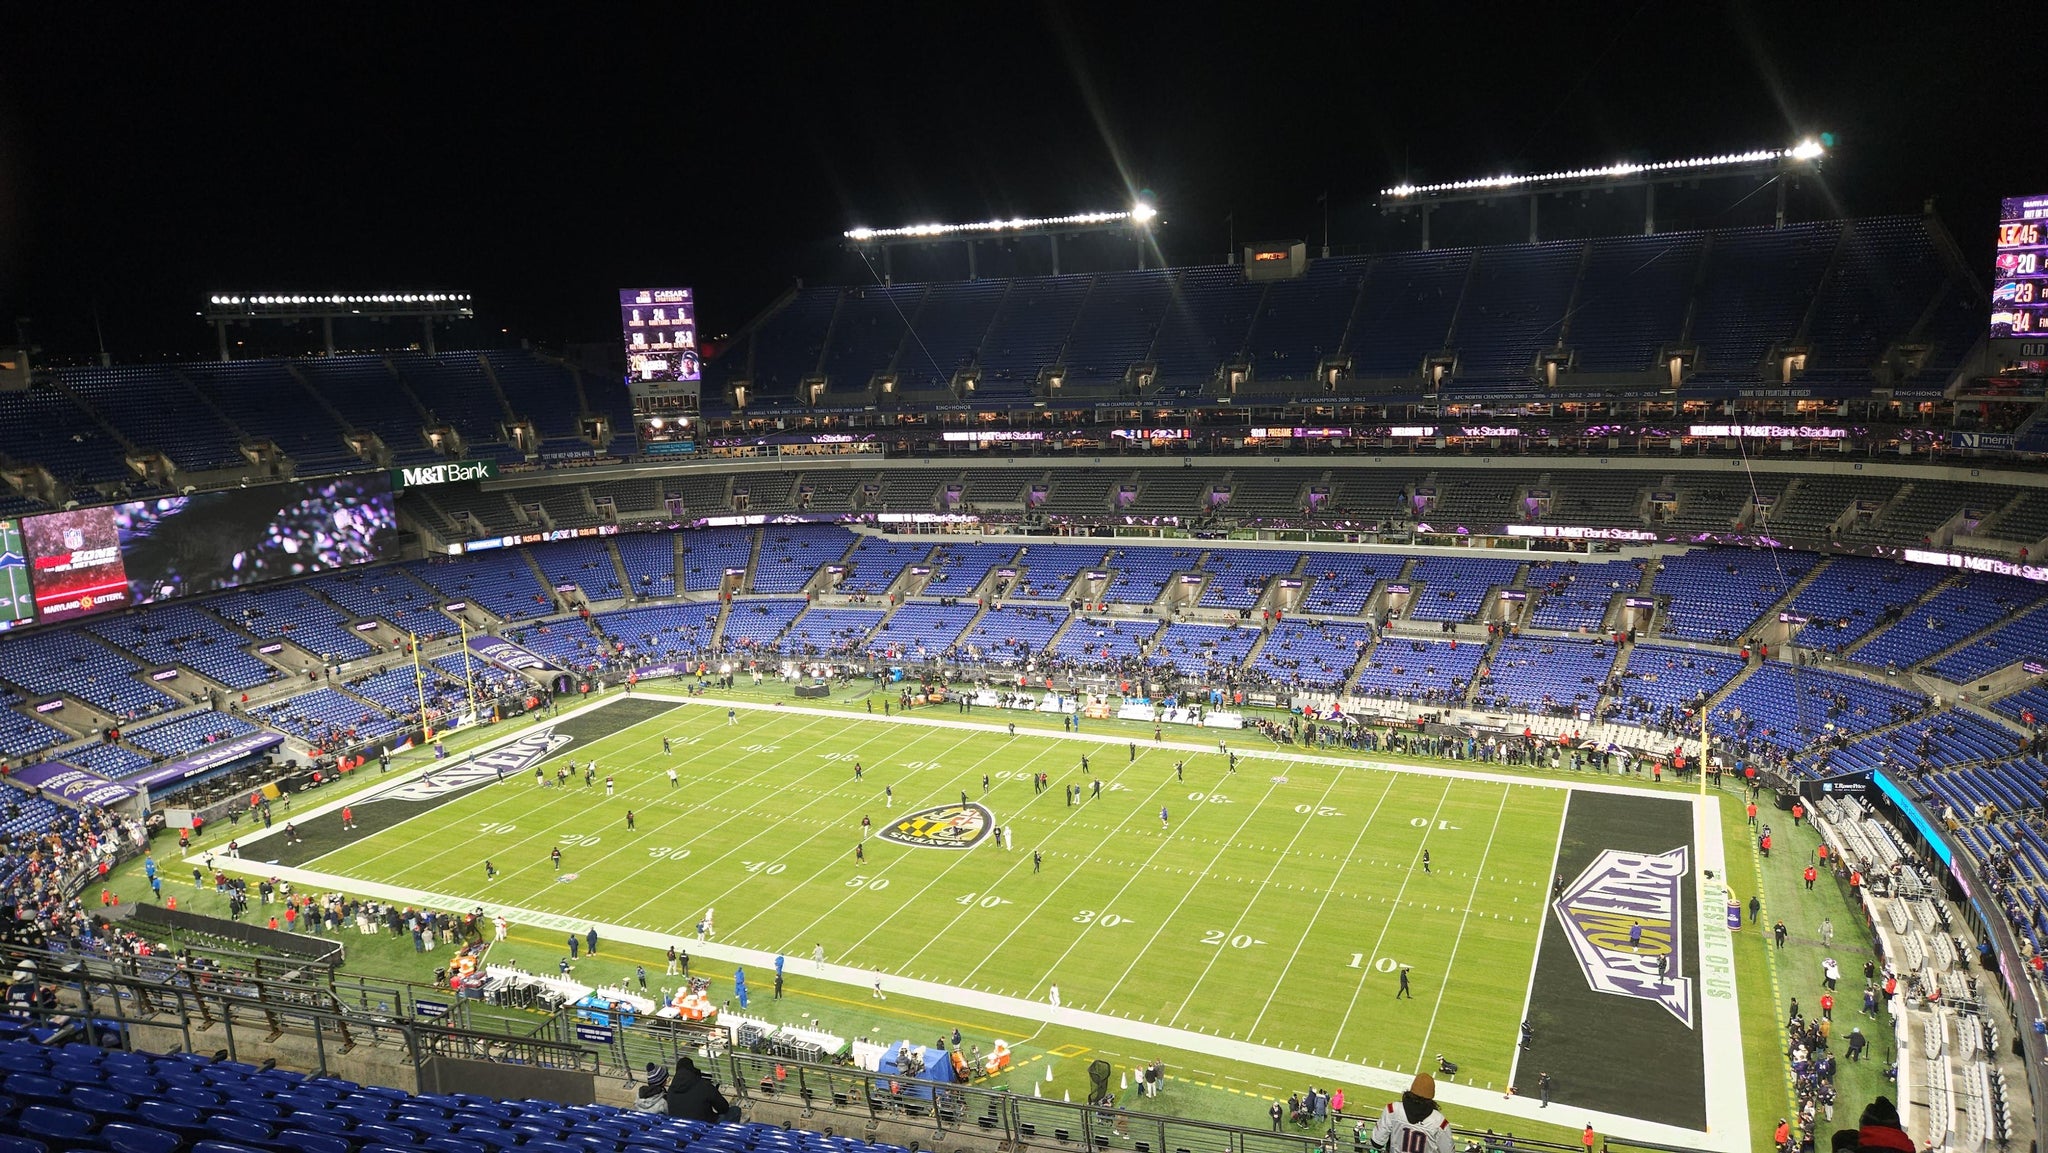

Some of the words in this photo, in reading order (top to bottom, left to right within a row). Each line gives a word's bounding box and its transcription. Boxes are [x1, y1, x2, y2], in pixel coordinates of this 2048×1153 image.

[2020, 224, 2038, 244] 45
[2017, 253, 2036, 274] 20
[2015, 283, 2033, 302] 23
[2012, 312, 2029, 332] 34
[2023, 343, 2045, 356] OLD
[1267, 428, 1292, 437] PREGAME
[1480, 426, 1518, 436] Stadium
[1743, 426, 1772, 436] M&T
[1772, 426, 1799, 436] Bank
[401, 464, 447, 486] M&T
[449, 462, 489, 482] Bank
[1558, 526, 1585, 538] M&T
[1584, 528, 1611, 539] Bank
[71, 546, 118, 563] ZONE
[1964, 556, 1994, 571] M&T
[1994, 560, 2022, 576] Bank
[43, 600, 80, 614] MARYLAND
[94, 592, 124, 604] LOTTERY
[36, 700, 63, 713] GEICO
[747, 744, 782, 754] 20
[824, 752, 860, 762] 30
[388, 726, 557, 800] RAVENS
[905, 761, 942, 771] 40
[49, 773, 88, 789] HEALTH
[994, 770, 1032, 781] 50
[1188, 791, 1228, 803] 30
[1294, 803, 1337, 817] 20
[484, 822, 517, 836] 10
[1410, 817, 1451, 831] 10
[567, 834, 601, 848] 20
[889, 831, 966, 847] RAVENS
[655, 847, 692, 861] 30
[747, 860, 787, 876] 40
[845, 875, 890, 892] 50
[955, 892, 1001, 909] 40
[1072, 909, 1125, 928] 30
[1199, 929, 1254, 949] 20
[1568, 849, 1692, 1027] BALTIMORE
[1704, 924, 1728, 948] ALL
[1345, 952, 1399, 974] 10
[1706, 955, 1729, 974] OF
[1706, 978, 1732, 1000] US
[1402, 1127, 1427, 1153] 10
